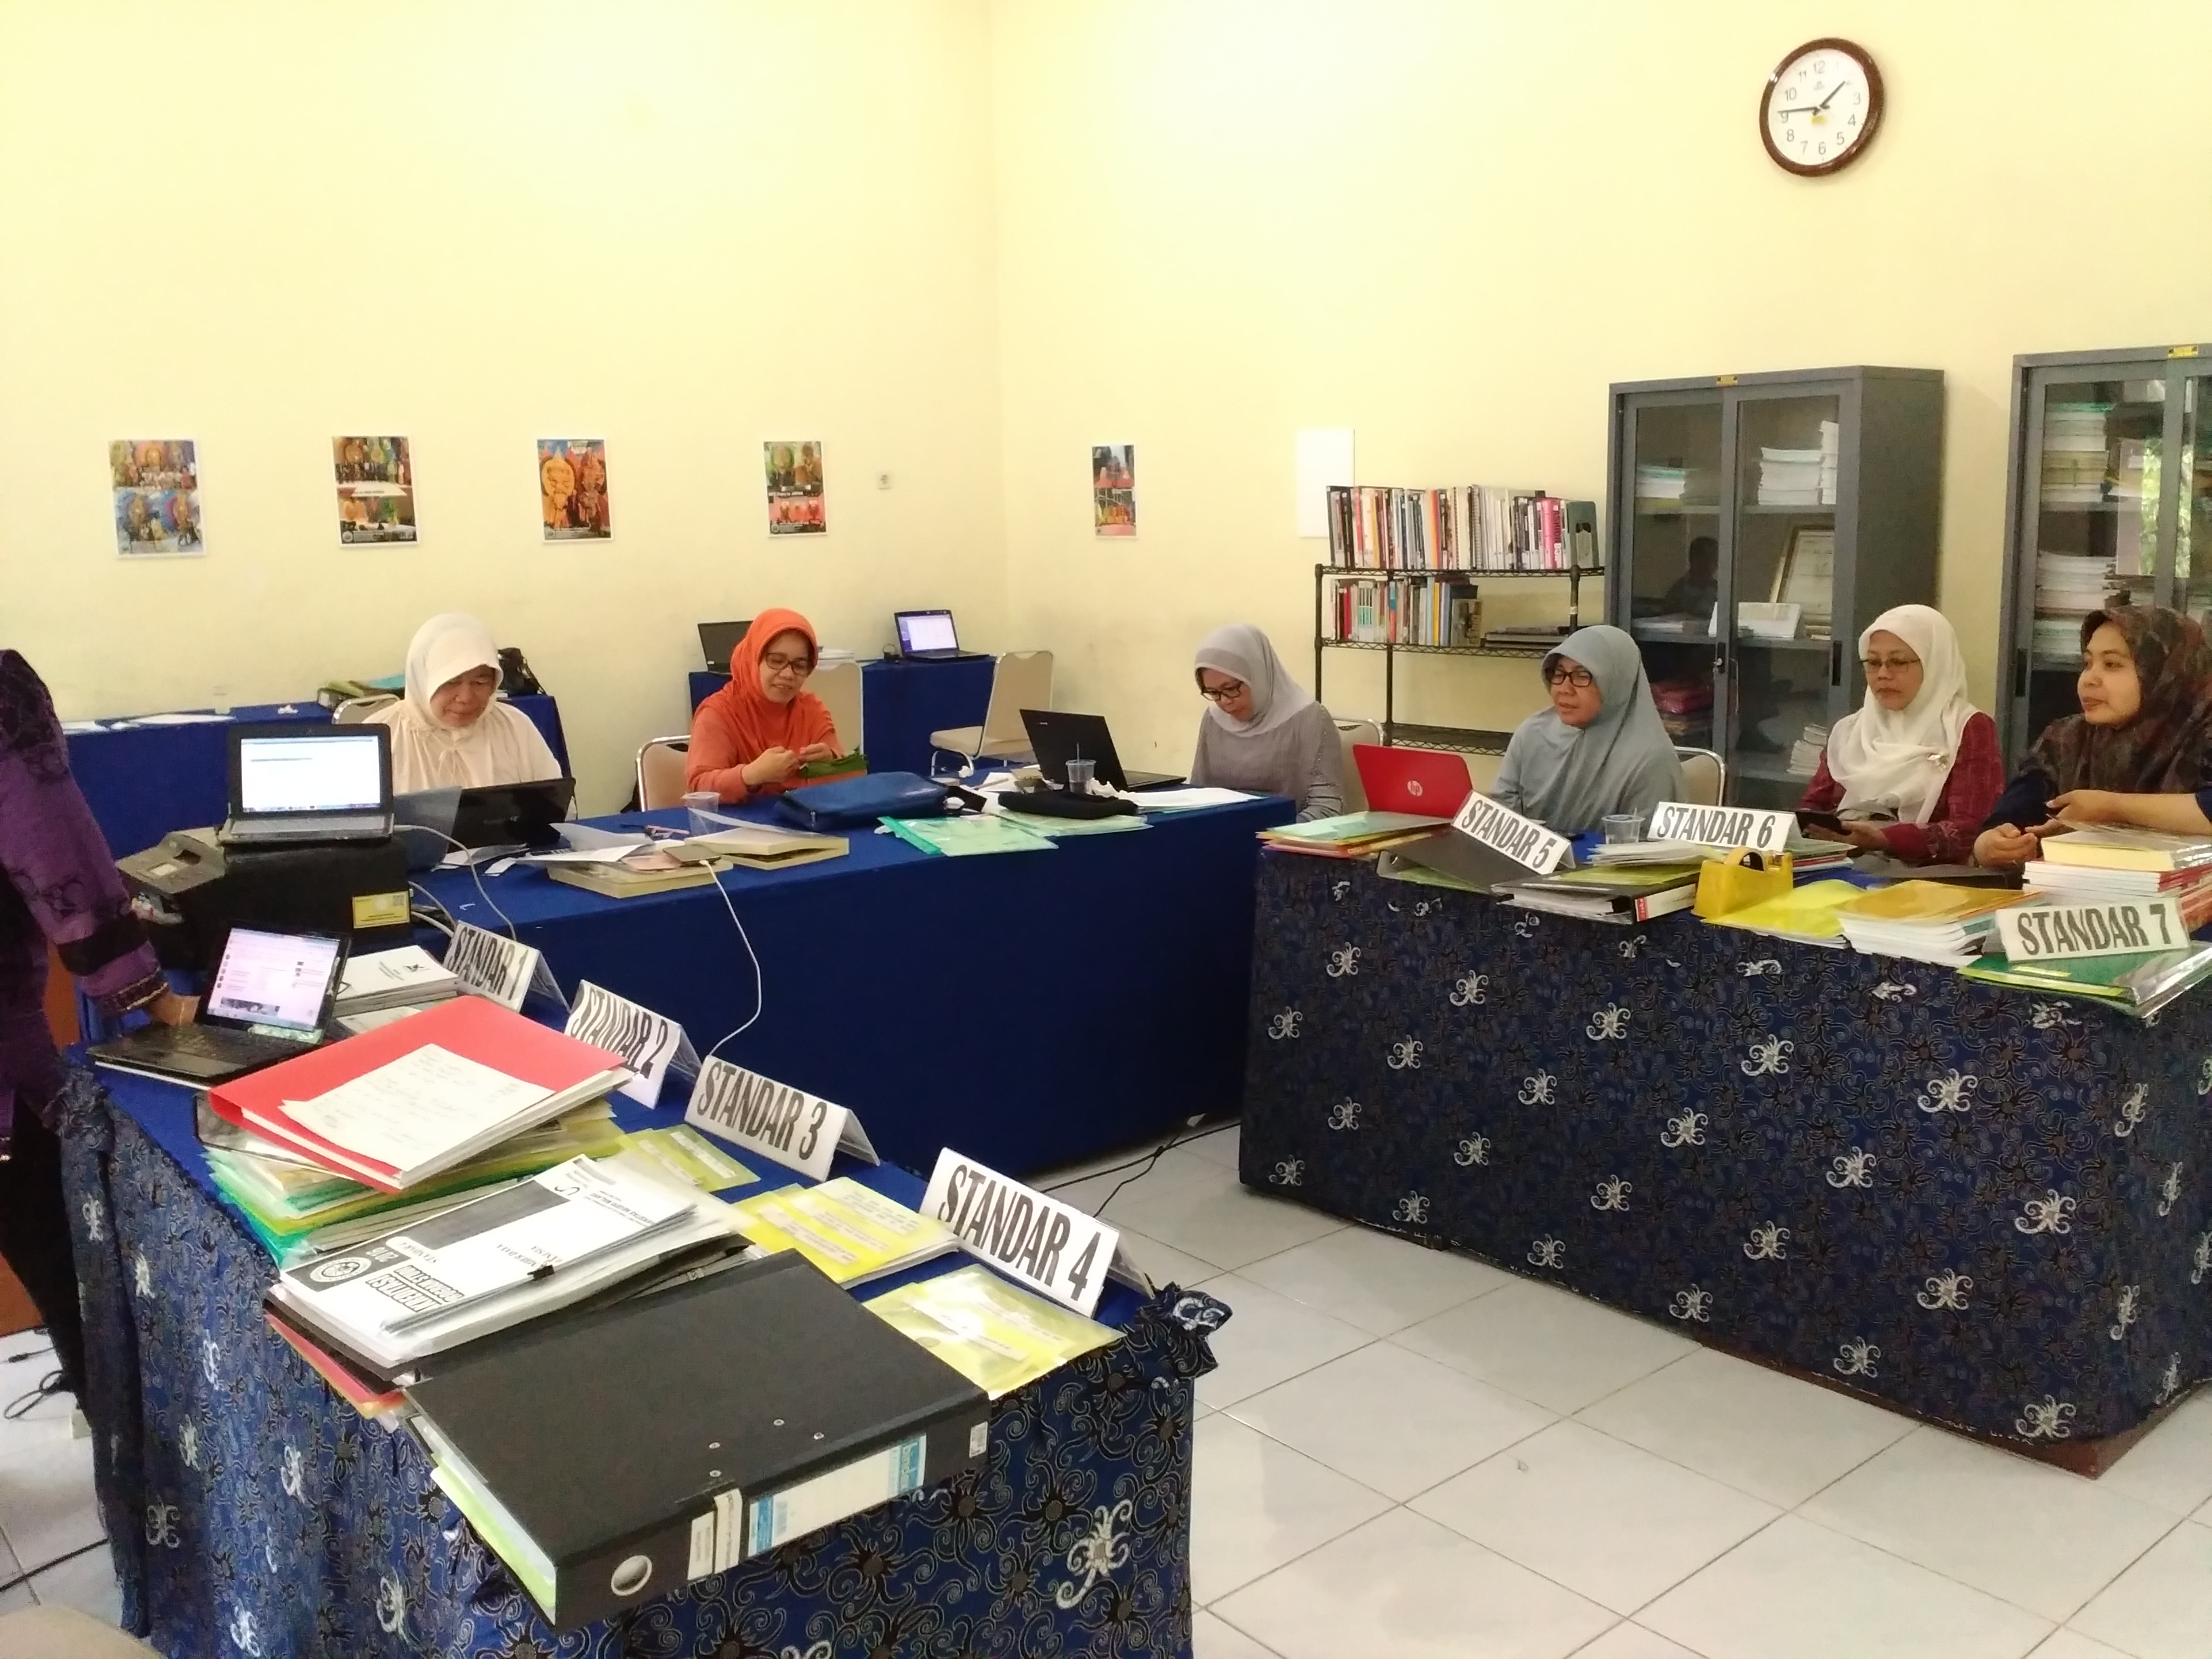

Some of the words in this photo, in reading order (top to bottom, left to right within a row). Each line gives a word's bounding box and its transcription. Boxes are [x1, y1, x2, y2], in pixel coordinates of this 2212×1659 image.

[1813, 60, 1826, 75] 12
[1799, 70, 1807, 83] 11
[1784, 87, 1797, 101] 10
[1853, 92, 1861, 105] 3
[1780, 111, 1789, 123] 9
[1847, 113, 1856, 127] 4
[1786, 129, 1795, 142] 8
[1836, 131, 1845, 145] 5
[1800, 140, 1808, 155] 7
[1818, 142, 1826, 155] 6
[1408, 780, 1422, 796] hp
[1461, 799, 1540, 862] STANDAR
[1532, 837, 1557, 869] 5
[1656, 806, 1754, 846] STANDAR
[1757, 815, 1776, 848] 6
[2018, 905, 2149, 956] STANDAR
[2149, 903, 2171, 944] 7
[447, 926, 515, 996] STANDAR
[508, 949, 529, 1001] 1
[571, 987, 652, 1073] STANDAR
[640, 1019, 668, 1080] 2
[697, 1061, 805, 1152] STANDAR
[798, 1101, 827, 1161] 3
[937, 1164, 1071, 1288] STANDAR
[1067, 1231, 1101, 1301] 4
